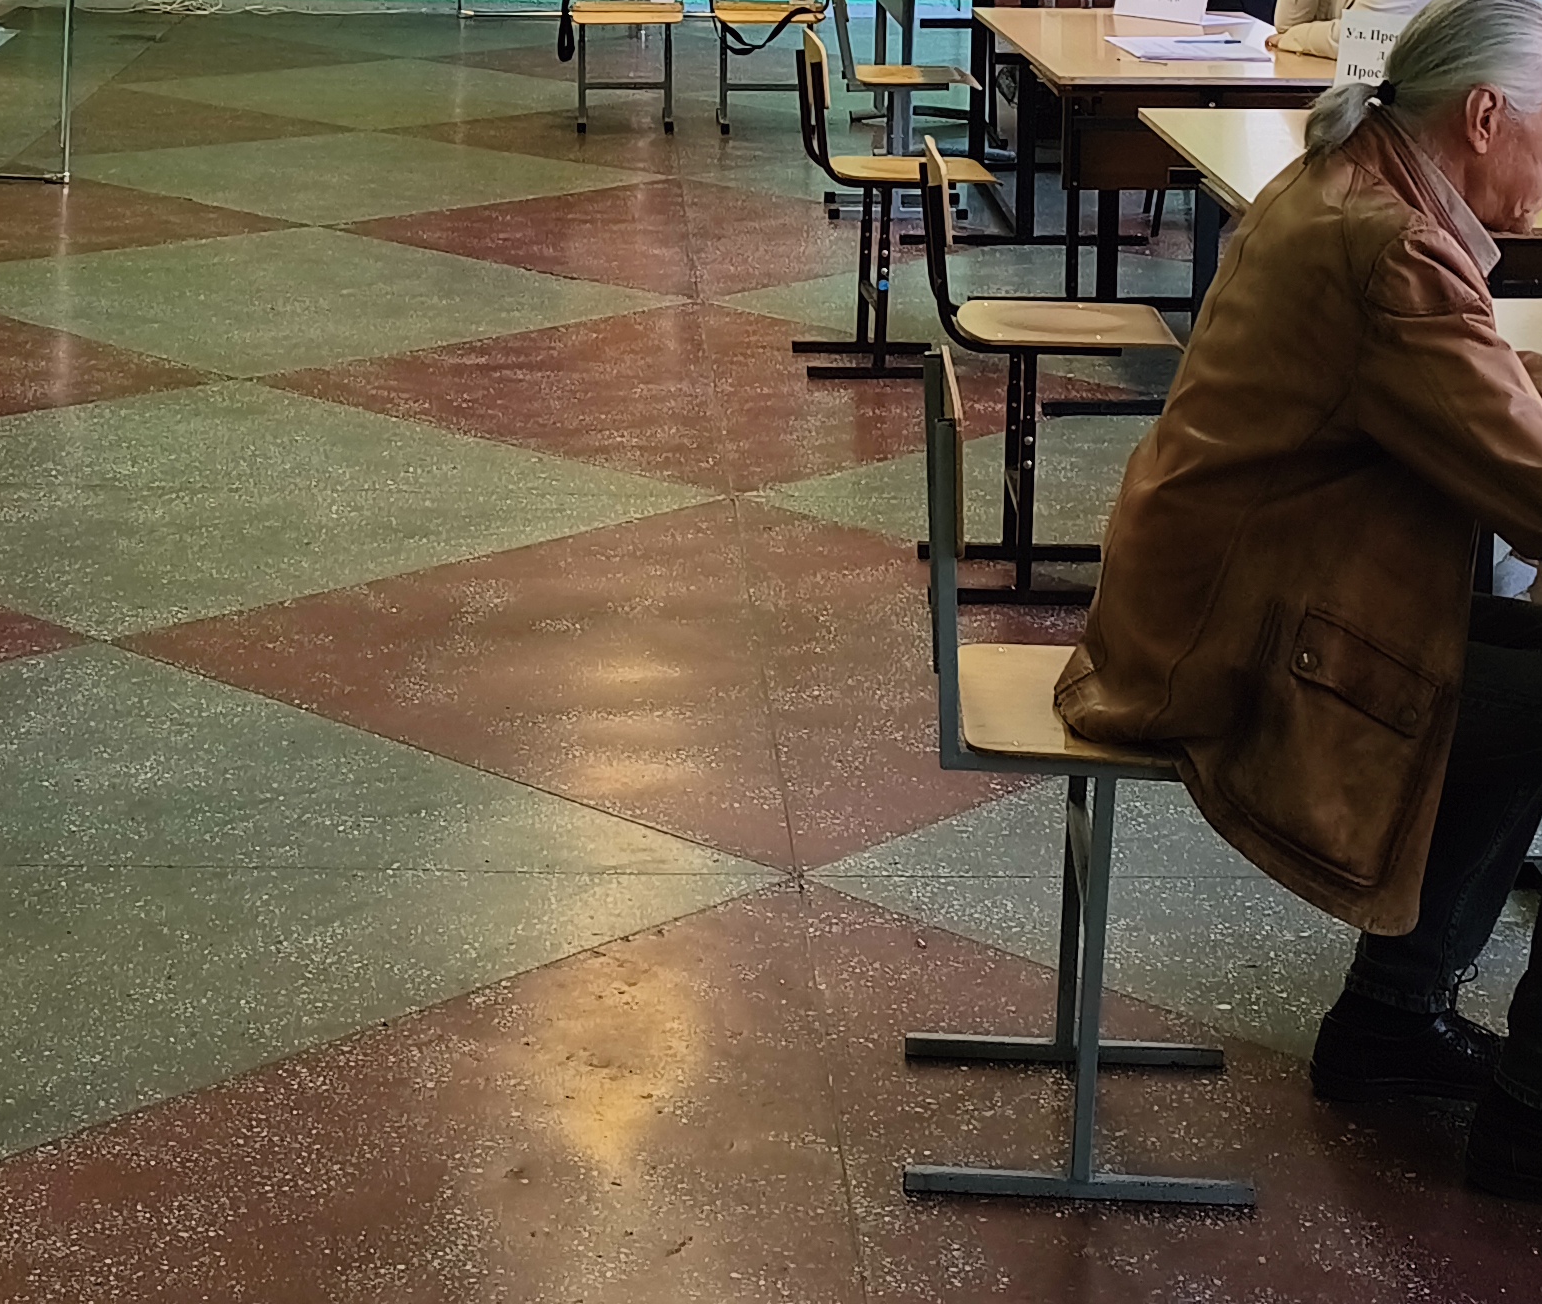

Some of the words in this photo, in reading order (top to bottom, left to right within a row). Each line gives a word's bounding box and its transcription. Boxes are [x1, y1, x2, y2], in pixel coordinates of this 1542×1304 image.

[1346, 27, 1366, 40] Ул.
[1371, 29, 1399, 44] Пре
[1347, 63, 1388, 80] Прос
